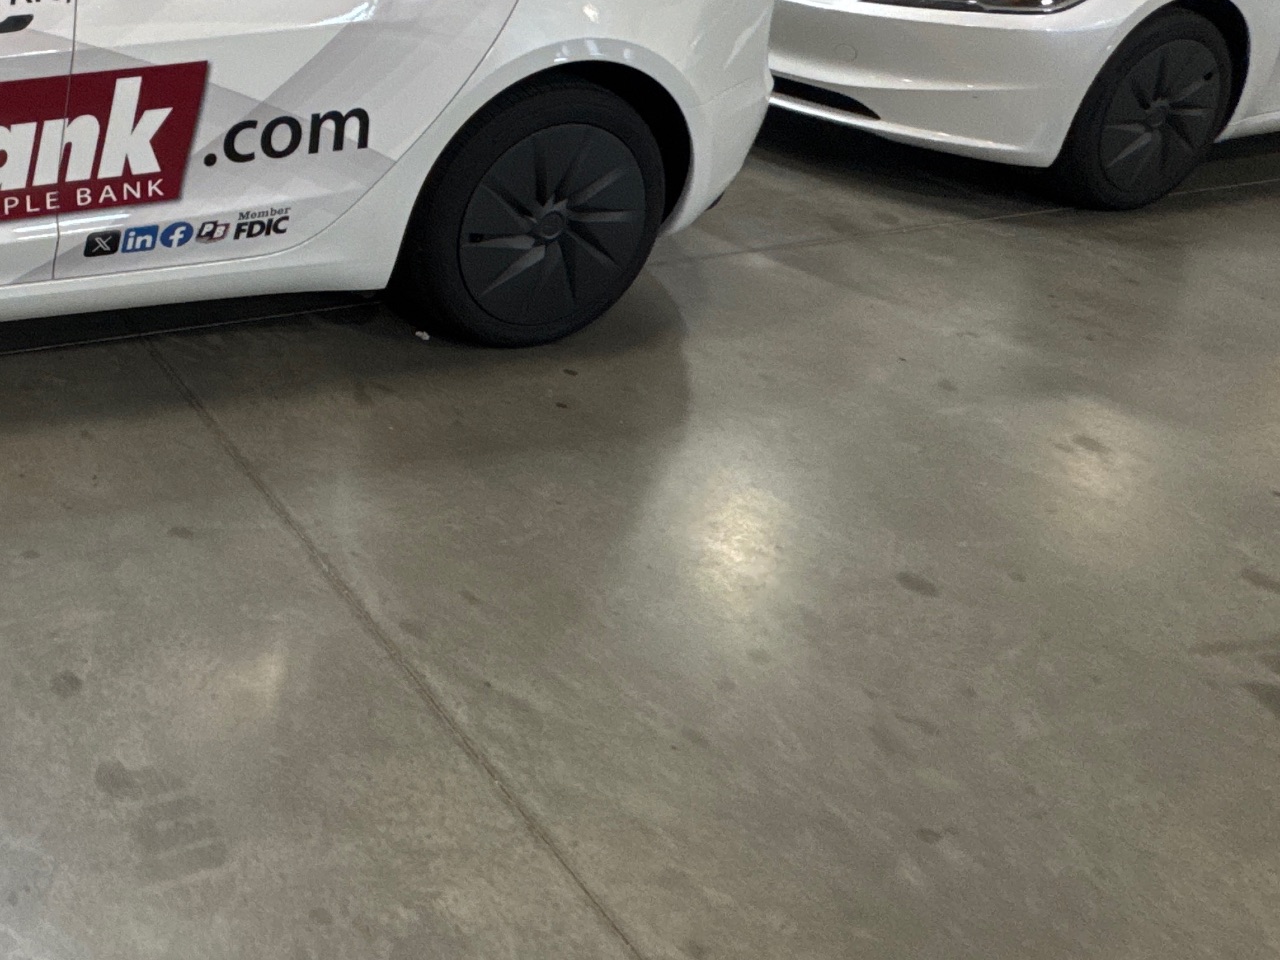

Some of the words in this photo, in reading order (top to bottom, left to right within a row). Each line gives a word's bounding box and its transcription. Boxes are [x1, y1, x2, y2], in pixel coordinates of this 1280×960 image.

[76, 178, 165, 207] BANK
[238, 207, 291, 220] Member
[233, 216, 290, 240] FDIC
